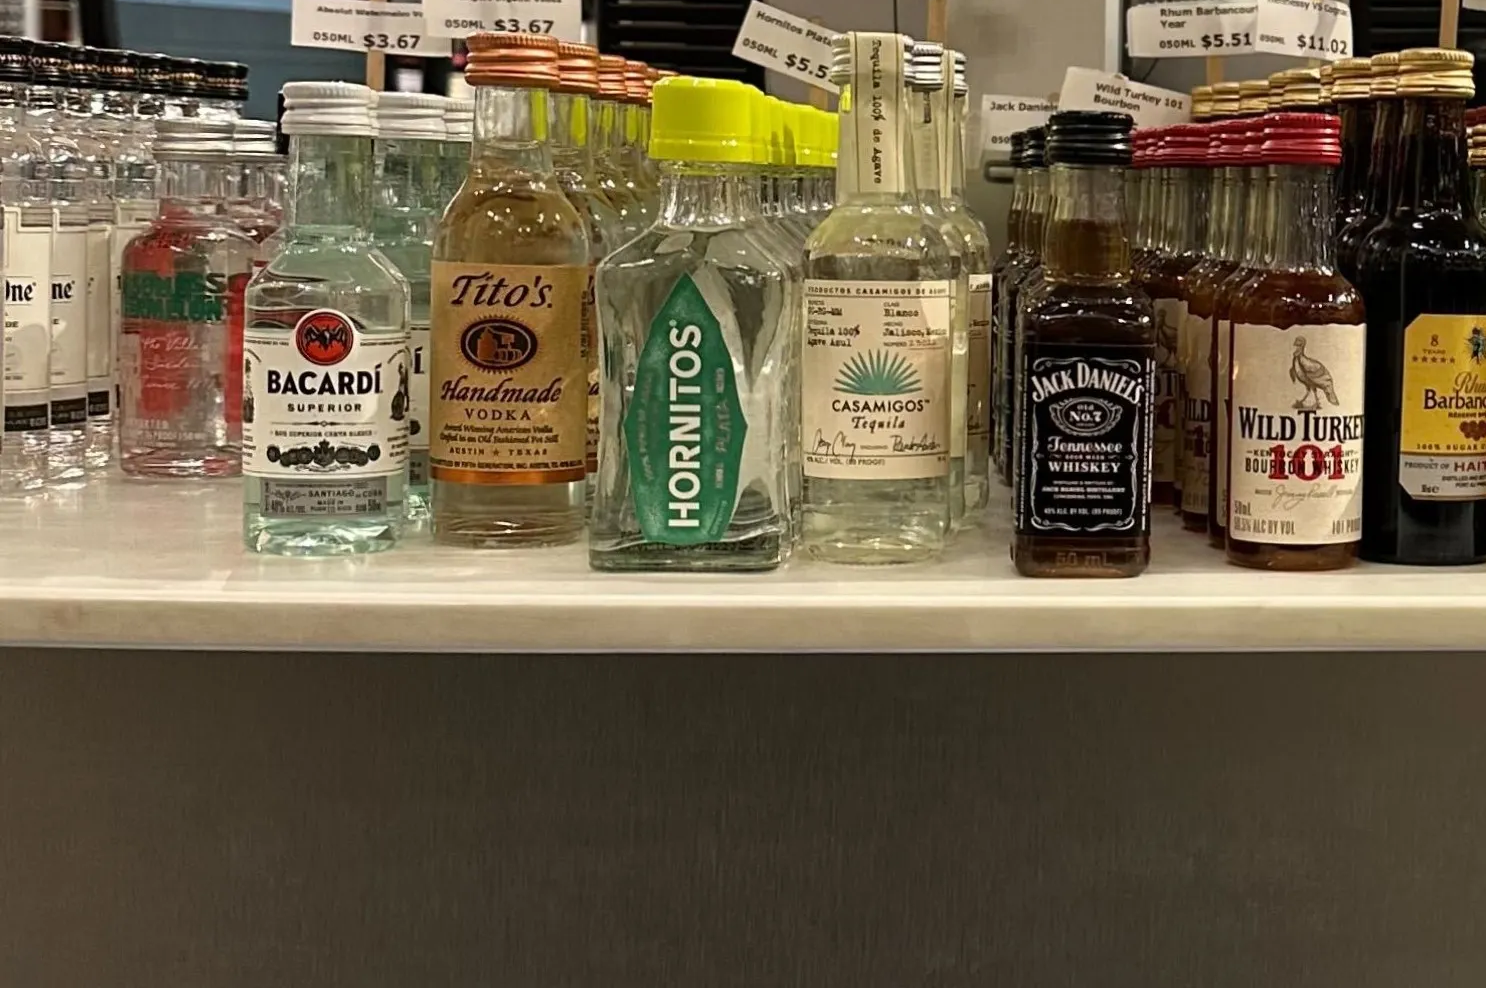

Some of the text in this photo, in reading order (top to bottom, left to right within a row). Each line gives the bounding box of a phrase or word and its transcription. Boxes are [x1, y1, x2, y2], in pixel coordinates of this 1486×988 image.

[1160, 7, 1193, 17] Rhum
[444, 18, 555, 35] 050ML $3.67
[756, 10, 803, 35] Hornitos
[1160, 19, 1187, 29] Year
[313, 31, 420, 50] 050ML $3.67
[1159, 32, 1252, 49] 050ML $5.51
[1296, 34, 1348, 56] $11.02
[742, 37, 833, 83] 050ML $5.5
[871, 38, 882, 89] Tequila
[1093, 94, 1141, 112] Bourbon
[1095, 82, 1184, 110] Wild Turkey 101
[989, 101, 1015, 112] Jack
[871, 147, 882, 185] Agave
[5, 282, 34, 302] ne
[450, 271, 554, 308] Tito's
[883, 308, 919, 318] Blanco
[1430, 334, 1439, 347] 8
[267, 362, 383, 395] BACARDÍ
[1031, 362, 1145, 405] JACK DANIEL'S
[440, 374, 563, 404] Handmade
[287, 403, 362, 413] SUPERIOR
[464, 408, 532, 421] VODKA
[832, 399, 925, 413] CASAMIGOS
[668, 323, 702, 528] HORNITOS
[851, 415, 905, 434] Tequila
[1238, 405, 1297, 441] WILD
[449, 447, 548, 456] AUSTIN TEXAS
[1047, 436, 1123, 453] Tennessee
[1446, 443, 1478, 451] SUGAR
[1048, 461, 1121, 473] WHISKEY
[1268, 443, 1346, 482] 101
[1404, 461, 1439, 470] PRODUCT
[1440, 462, 1450, 470] OF
[308, 489, 355, 498] SANTIAGO
[1253, 518, 1267, 533] ALC
[1268, 519, 1279, 534] BY
